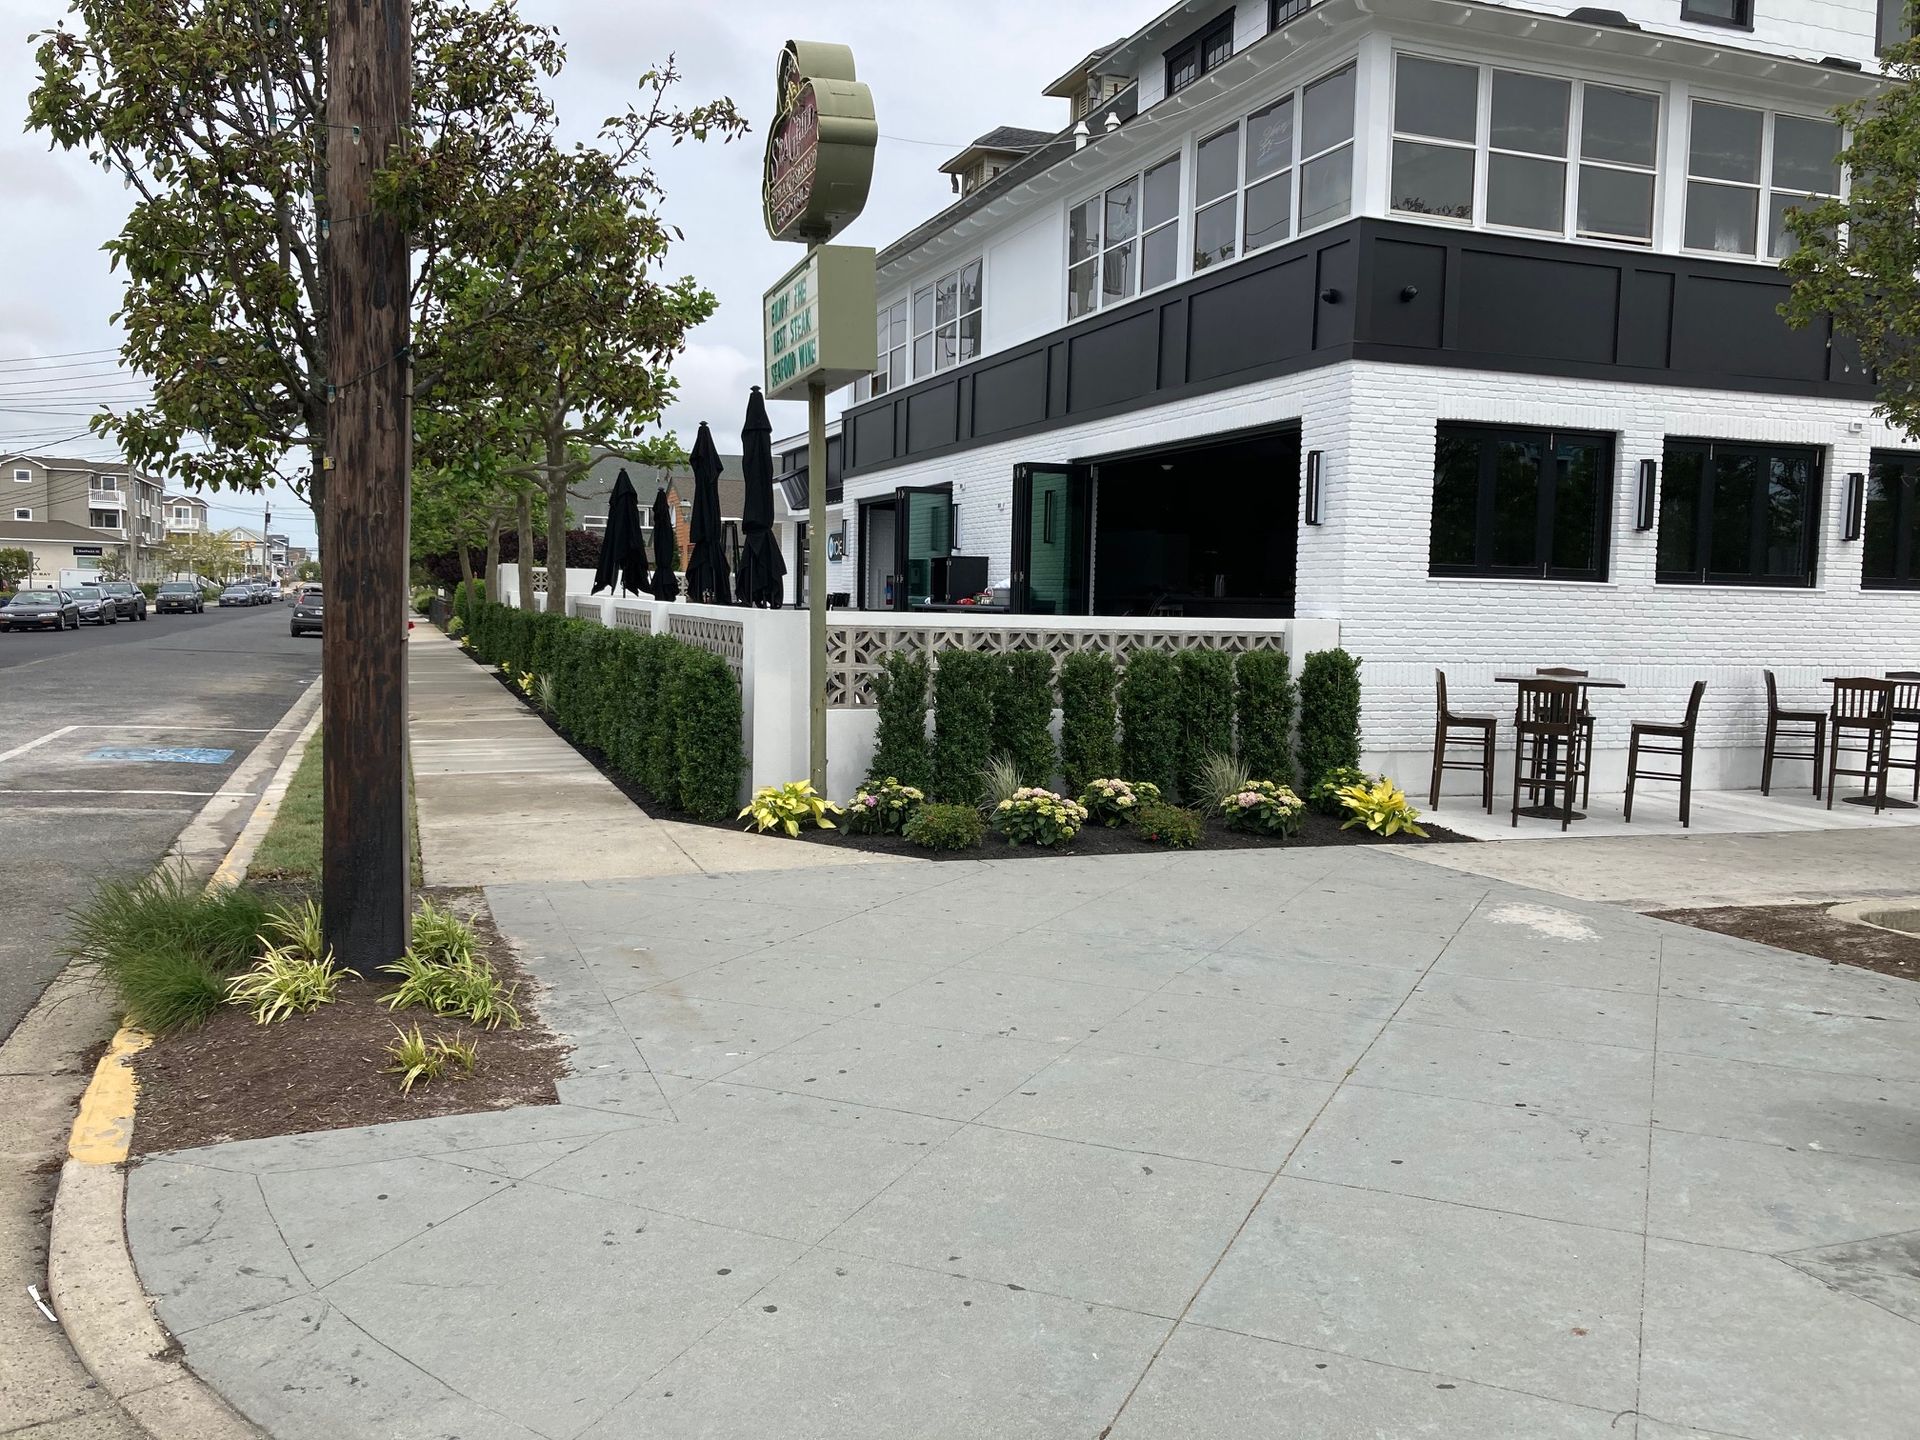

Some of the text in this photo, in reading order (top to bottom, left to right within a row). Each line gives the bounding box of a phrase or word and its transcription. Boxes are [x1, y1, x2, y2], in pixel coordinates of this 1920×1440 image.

[790, 307, 811, 343] STEAK
[771, 337, 816, 387] SEAFOOD WINE
